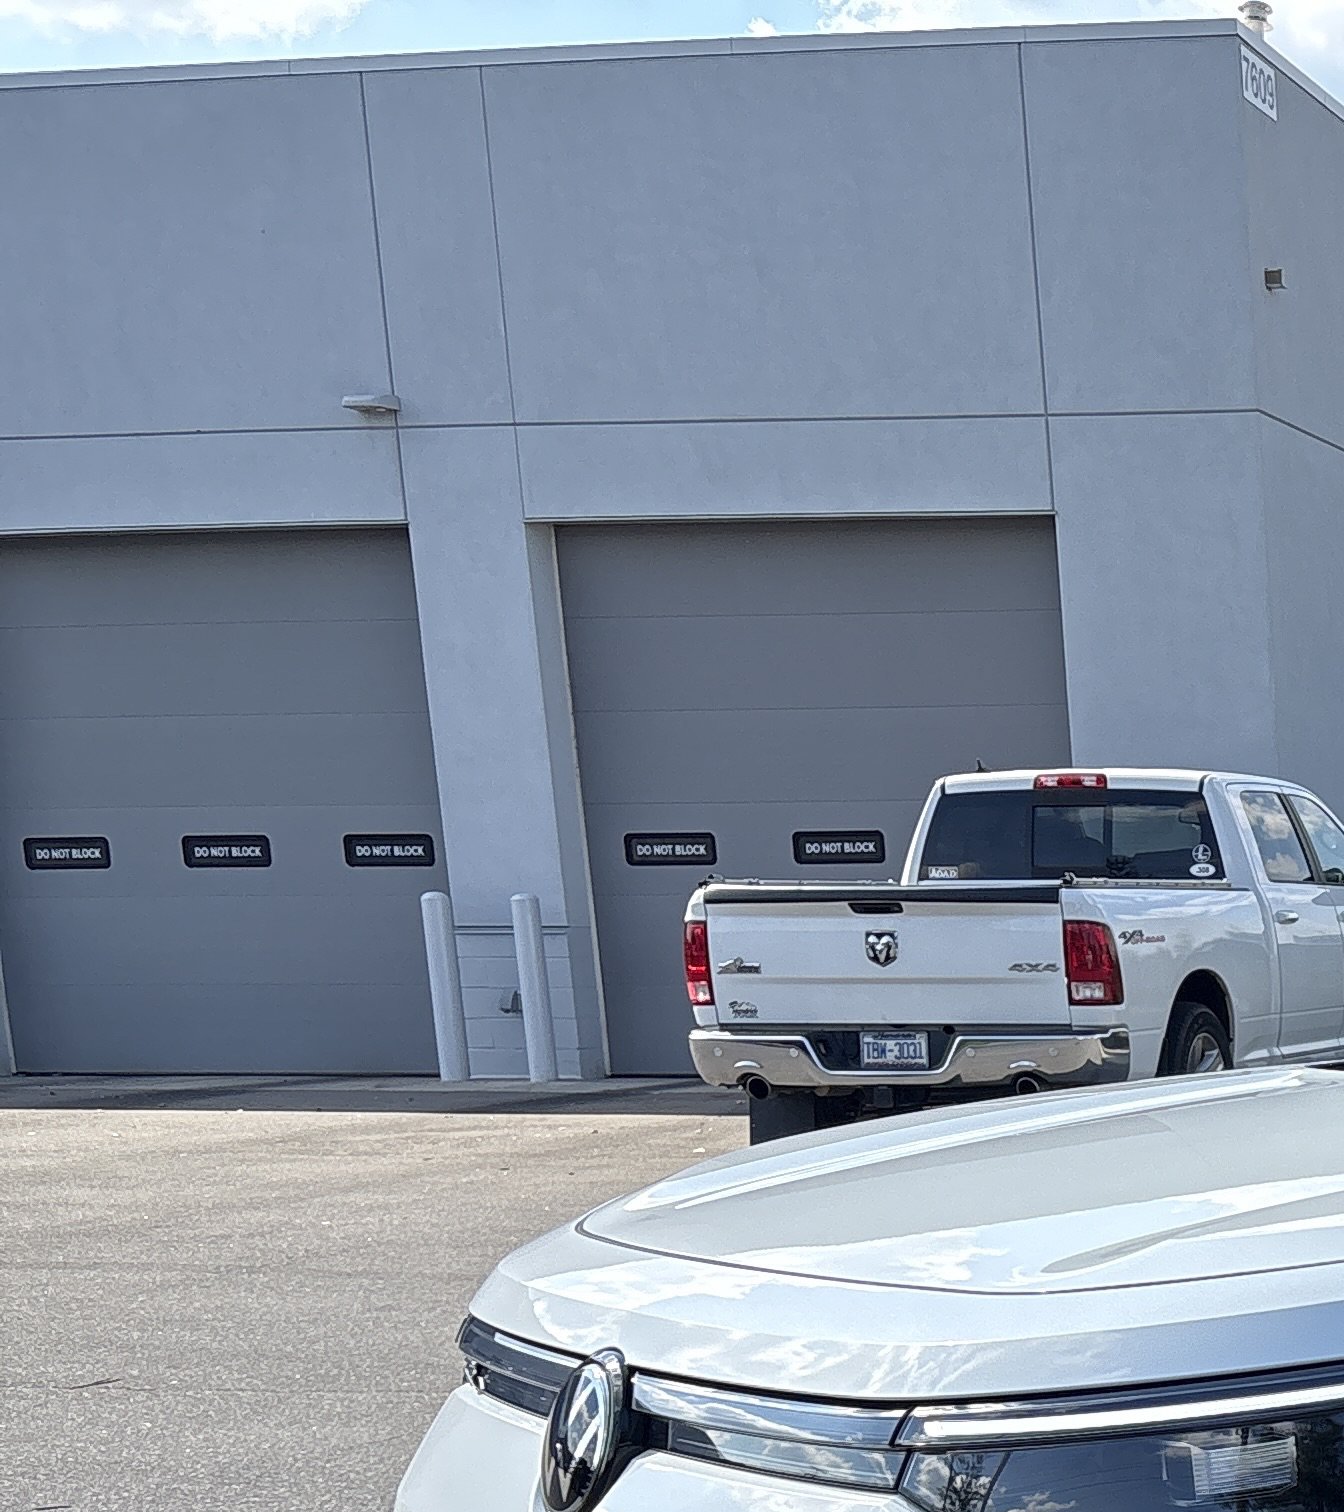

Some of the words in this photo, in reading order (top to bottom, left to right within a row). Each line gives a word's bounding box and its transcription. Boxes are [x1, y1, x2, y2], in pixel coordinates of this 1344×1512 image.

[1242, 54, 1275, 111] 7609
[35, 848, 50, 860] DO
[51, 848, 70, 859] NOT
[71, 847, 102, 859] BLOCK
[193, 846, 209, 857] DO
[210, 846, 230, 857] NOT
[231, 846, 262, 857] BLOCK
[355, 845, 371, 856] DO
[371, 845, 392, 856] NOT
[393, 845, 425, 856] BLOCK
[636, 844, 652, 855] DO
[653, 844, 673, 855] NOT
[674, 844, 707, 855] BLOCK
[805, 842, 820, 854] DO
[821, 842, 842, 853] NOT
[843, 841, 877, 853] BLOCK
